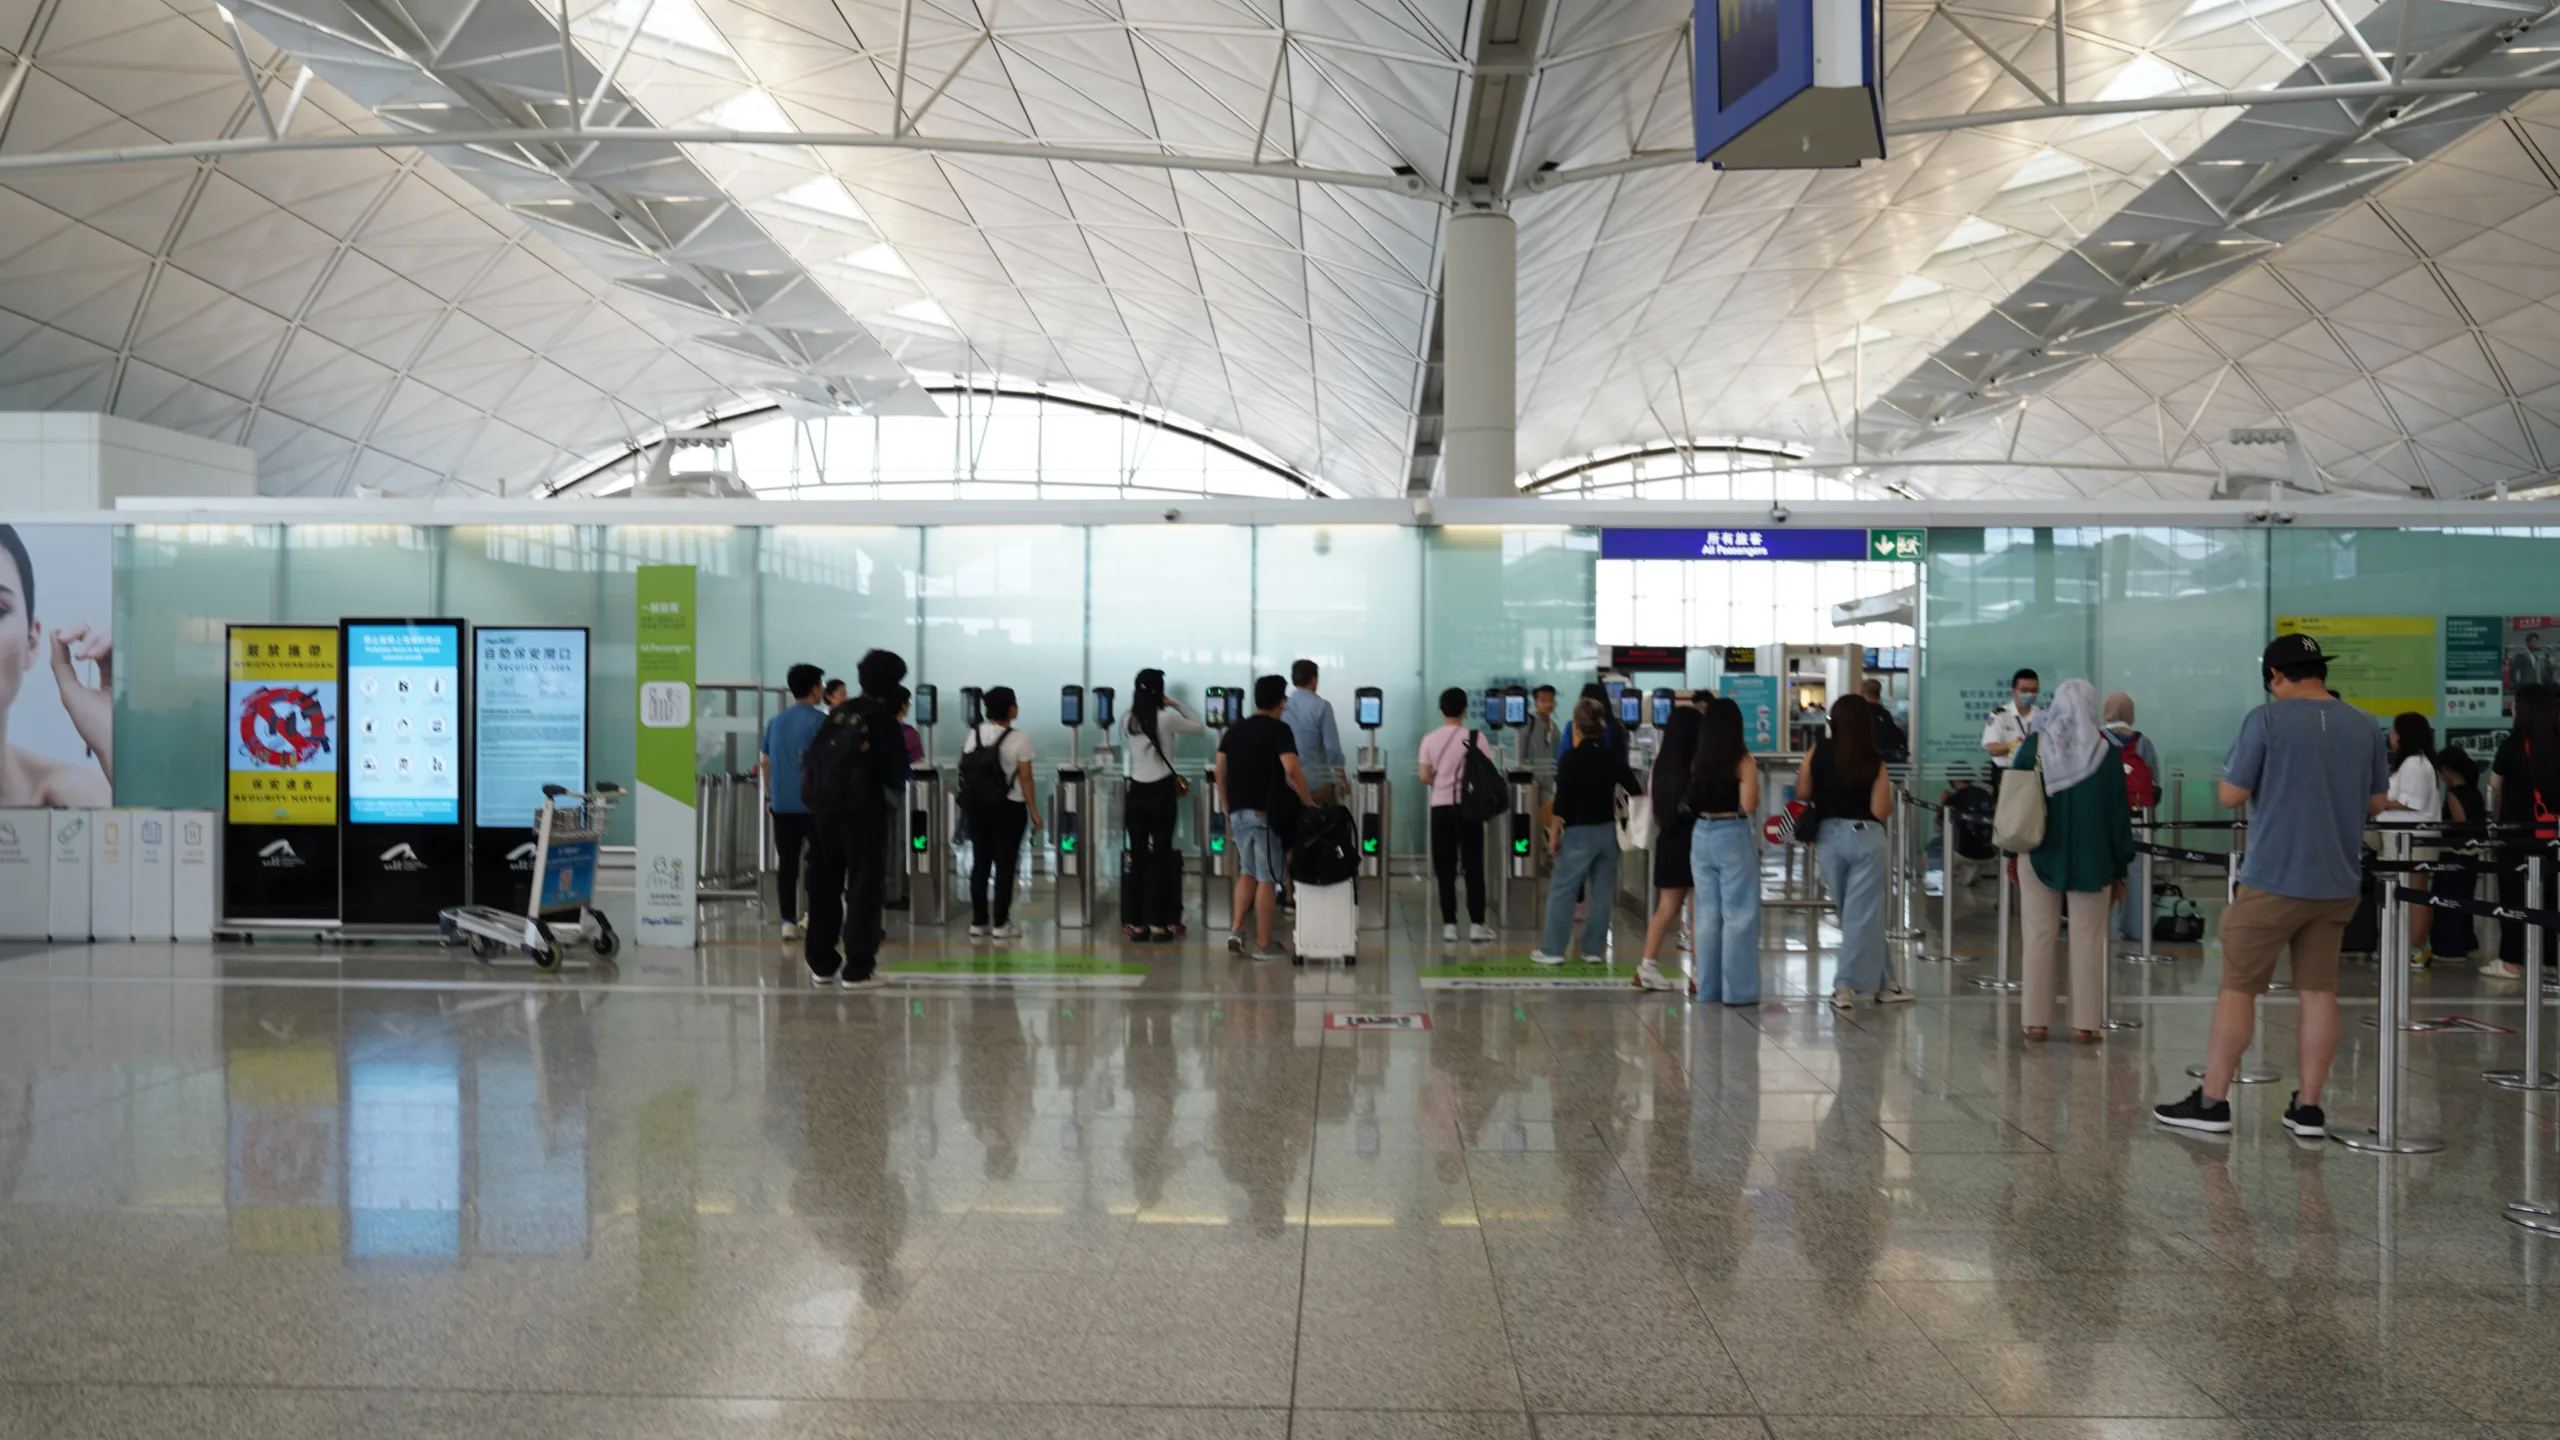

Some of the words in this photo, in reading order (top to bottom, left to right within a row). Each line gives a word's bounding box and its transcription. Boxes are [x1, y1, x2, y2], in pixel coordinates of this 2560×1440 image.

[1706, 531, 1763, 545] 所有旅客
[1701, 544, 1716, 556] All
[1717, 545, 1769, 557] Passengers
[650, 643, 692, 655] Passengers
[278, 661, 334, 669] FORBIDDEN
[484, 662, 538, 673] E-Security
[233, 794, 287, 803] SECURITY
[290, 794, 332, 803] NOTICE
